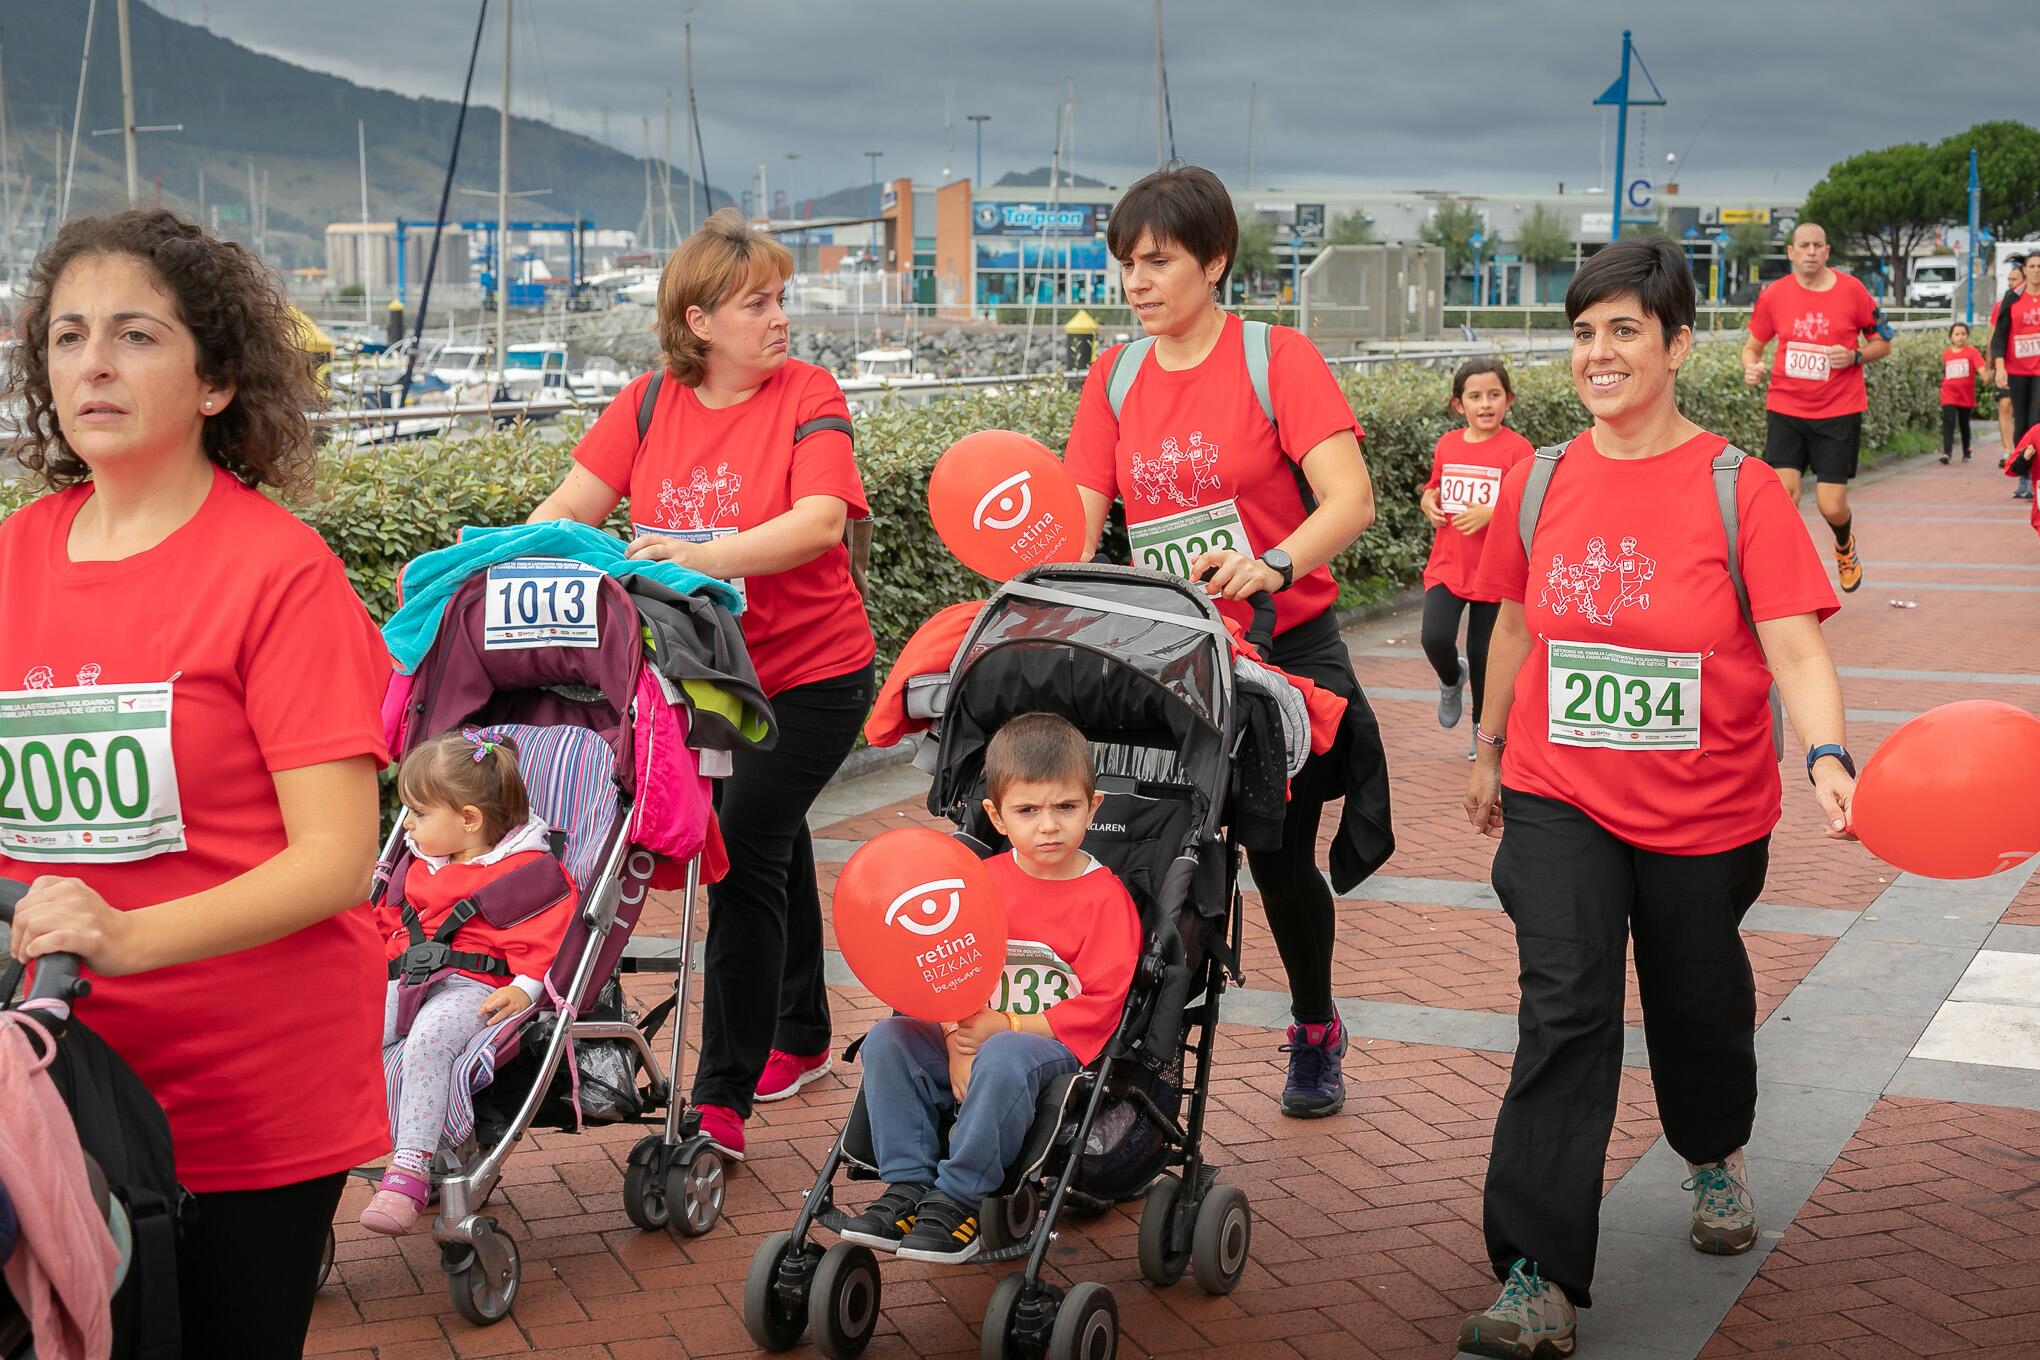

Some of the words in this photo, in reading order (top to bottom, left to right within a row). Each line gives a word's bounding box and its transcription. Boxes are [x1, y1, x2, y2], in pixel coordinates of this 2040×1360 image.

[1629, 180, 1651, 208] C
[1790, 353, 1826, 371] 3003
[1443, 479, 1491, 504] 3013
[1010, 513, 1054, 554] retina
[1020, 523, 1063, 563] BIZKAIA
[500, 580, 585, 624] 1013
[1564, 673, 1685, 727] 2034
[0, 735, 150, 822] 2060
[1088, 823, 1125, 832] CLAREN
[916, 932, 976, 967] retina
[923, 948, 982, 982] BIZKAIA
[932, 966, 982, 993] begisare
